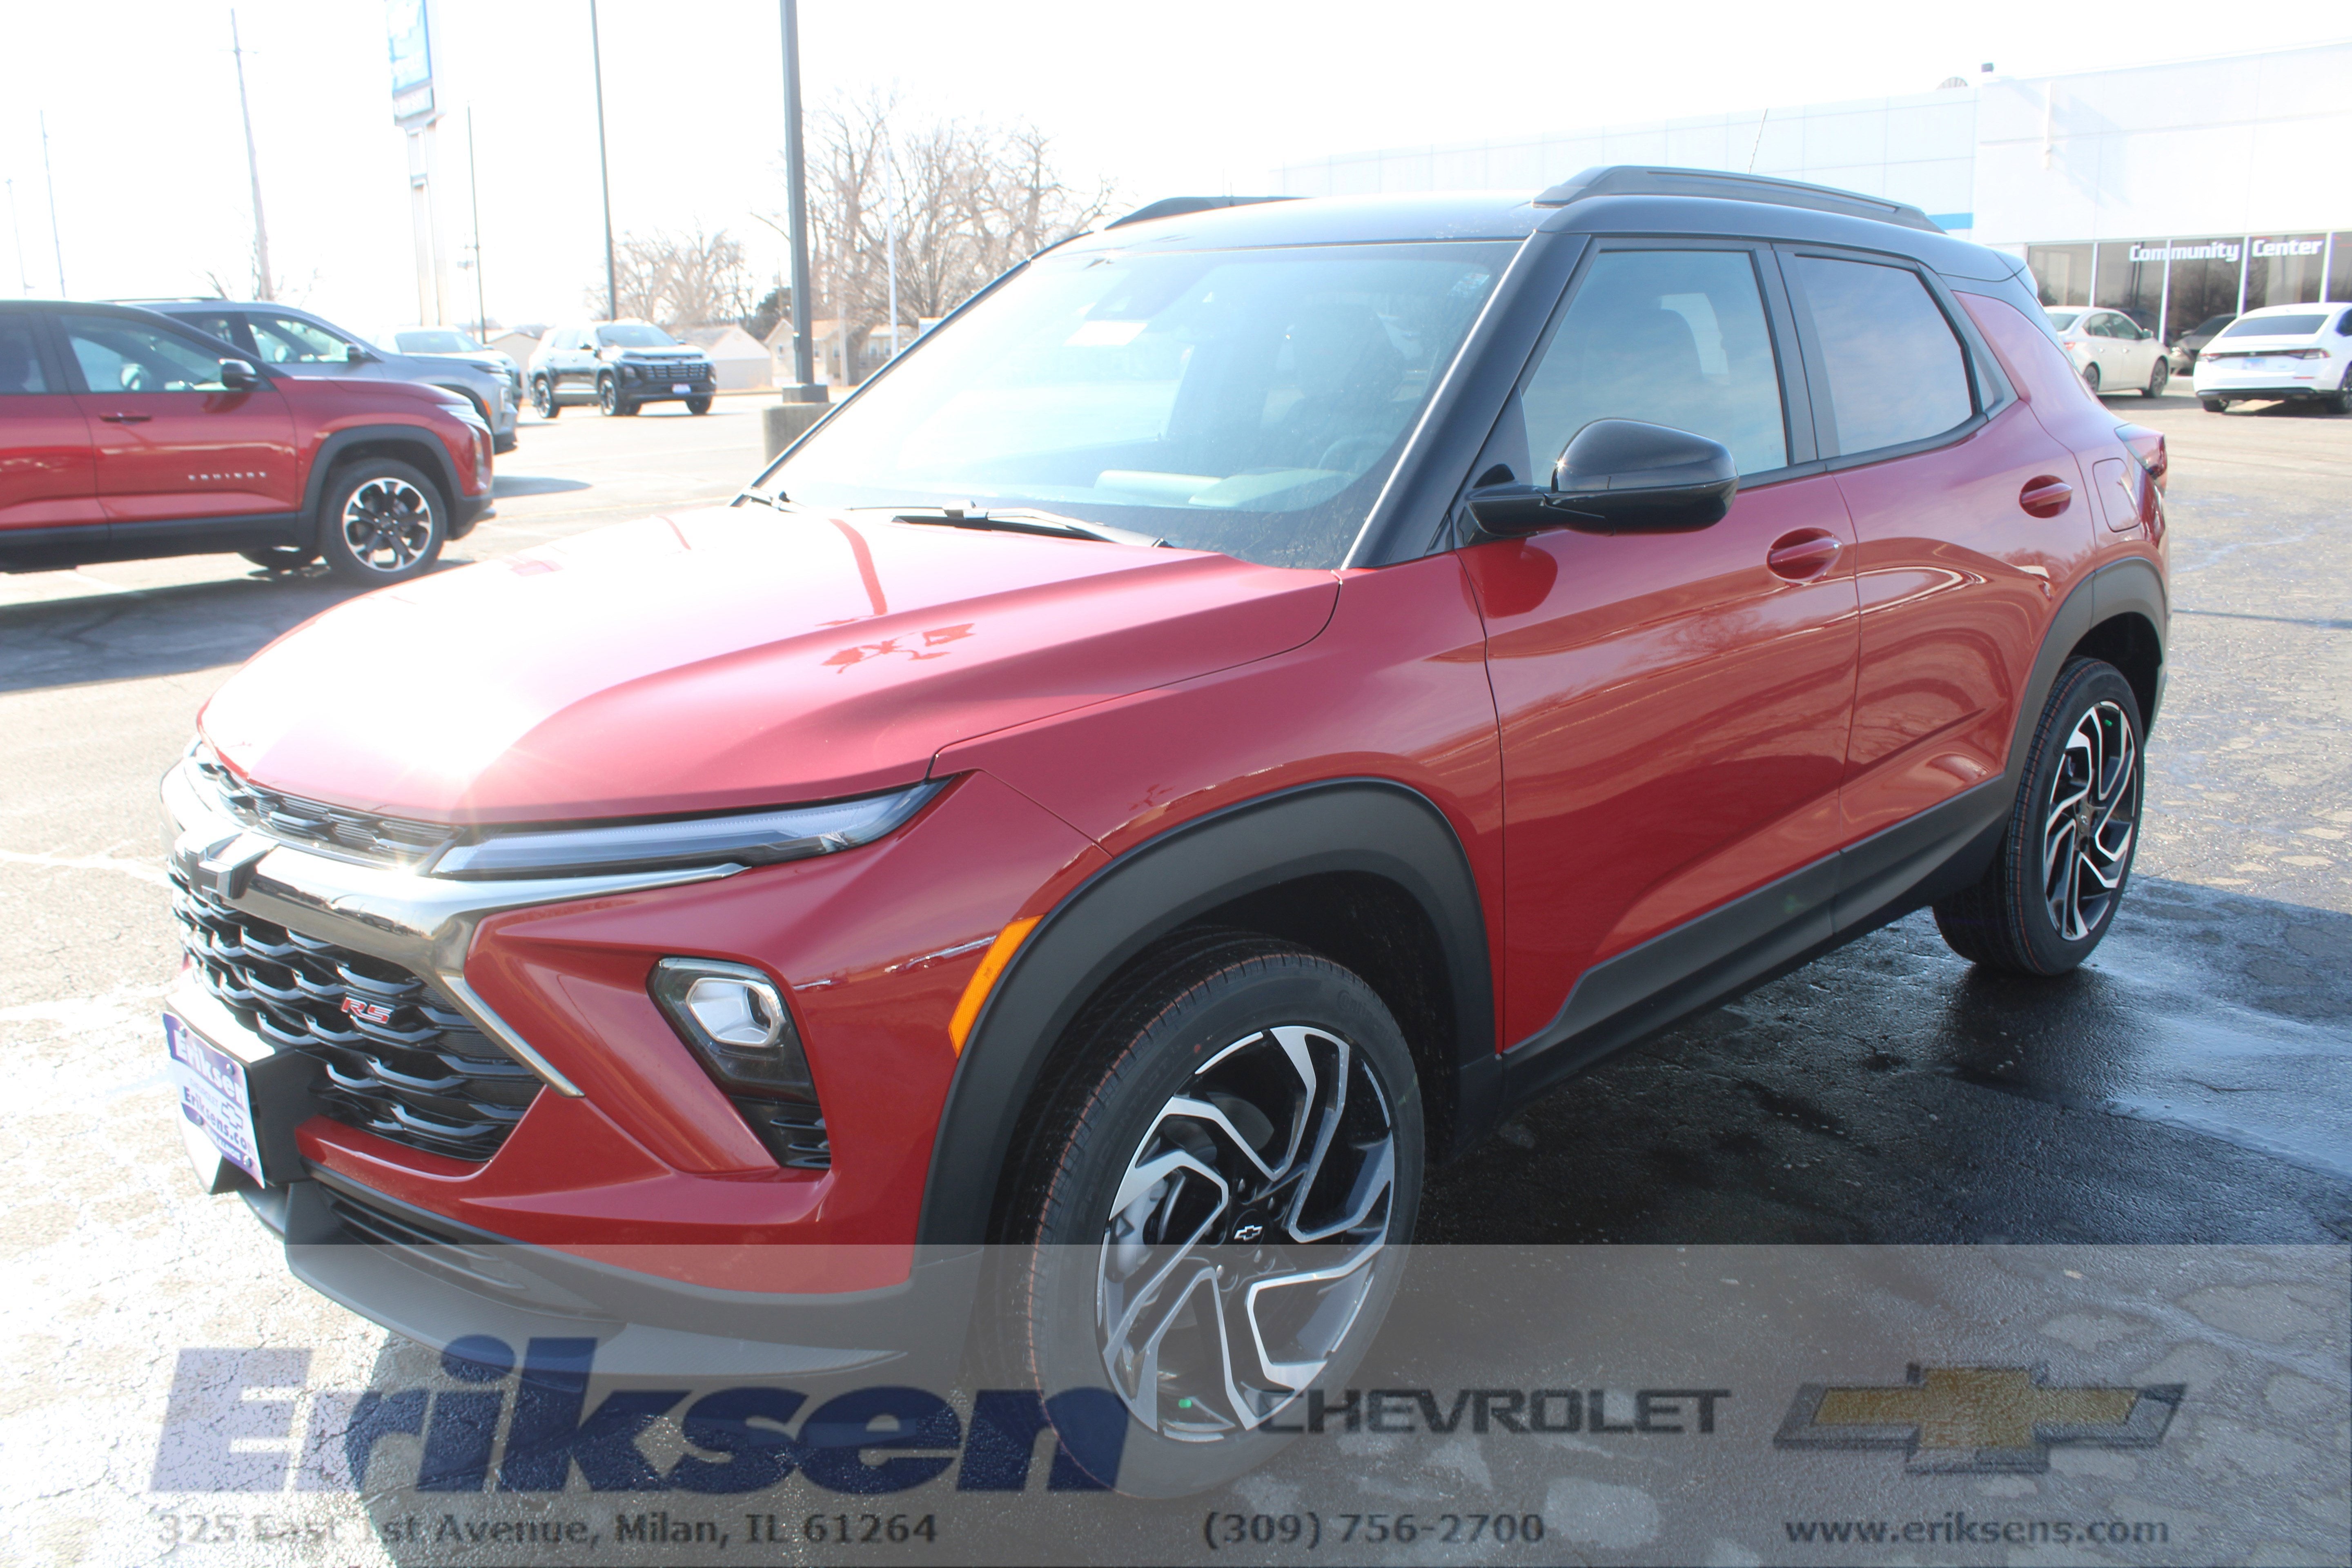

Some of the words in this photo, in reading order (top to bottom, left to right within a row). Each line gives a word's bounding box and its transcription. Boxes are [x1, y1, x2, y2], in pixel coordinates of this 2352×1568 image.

[2129, 241, 2241, 262] Community
[2252, 239, 2323, 257] Center
[341, 997, 394, 1024] RS
[174, 1029, 247, 1110] Eriksen
